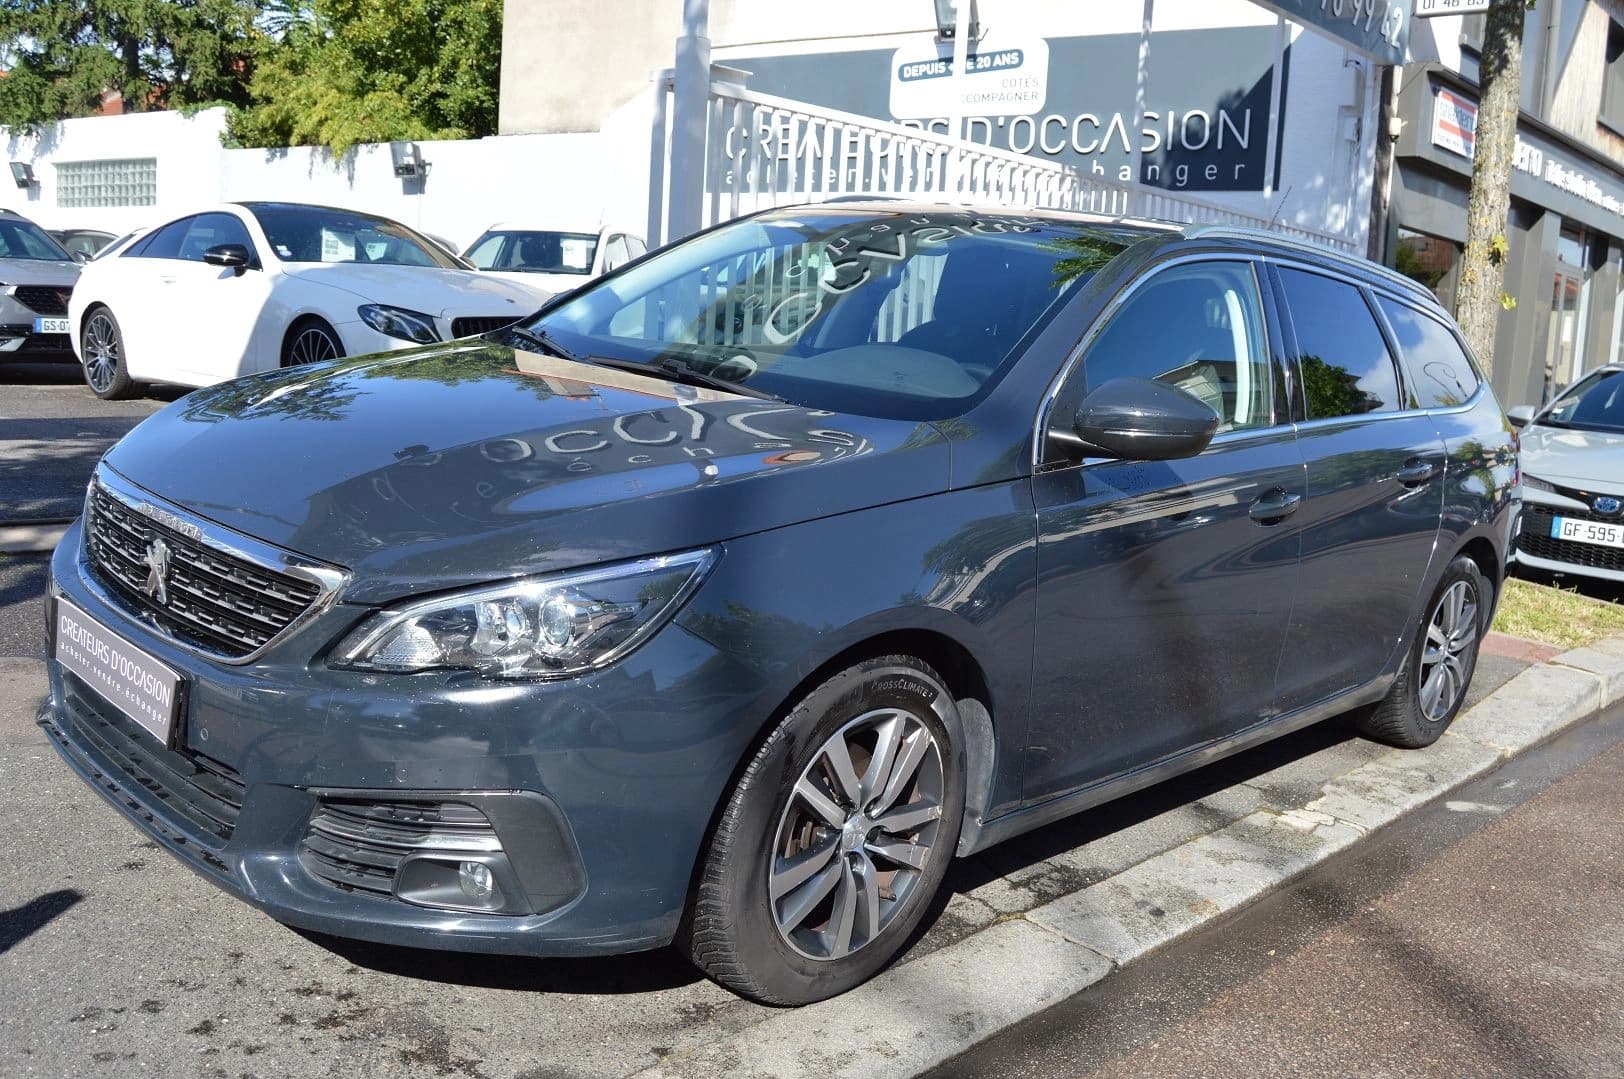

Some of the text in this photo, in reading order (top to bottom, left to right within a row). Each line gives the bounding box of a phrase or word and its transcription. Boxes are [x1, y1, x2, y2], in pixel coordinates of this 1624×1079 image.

[903, 62, 946, 79] DEPUIS
[977, 56, 990, 69] 20
[993, 53, 1019, 66] ANS
[963, 91, 1039, 103] COMPAGNER
[966, 109, 1250, 154] D'OCCASION
[44, 320, 70, 331] GS-0
[1564, 522, 1624, 544] GF-595-
[61, 615, 171, 708] CREATEURS D'OCCASION
